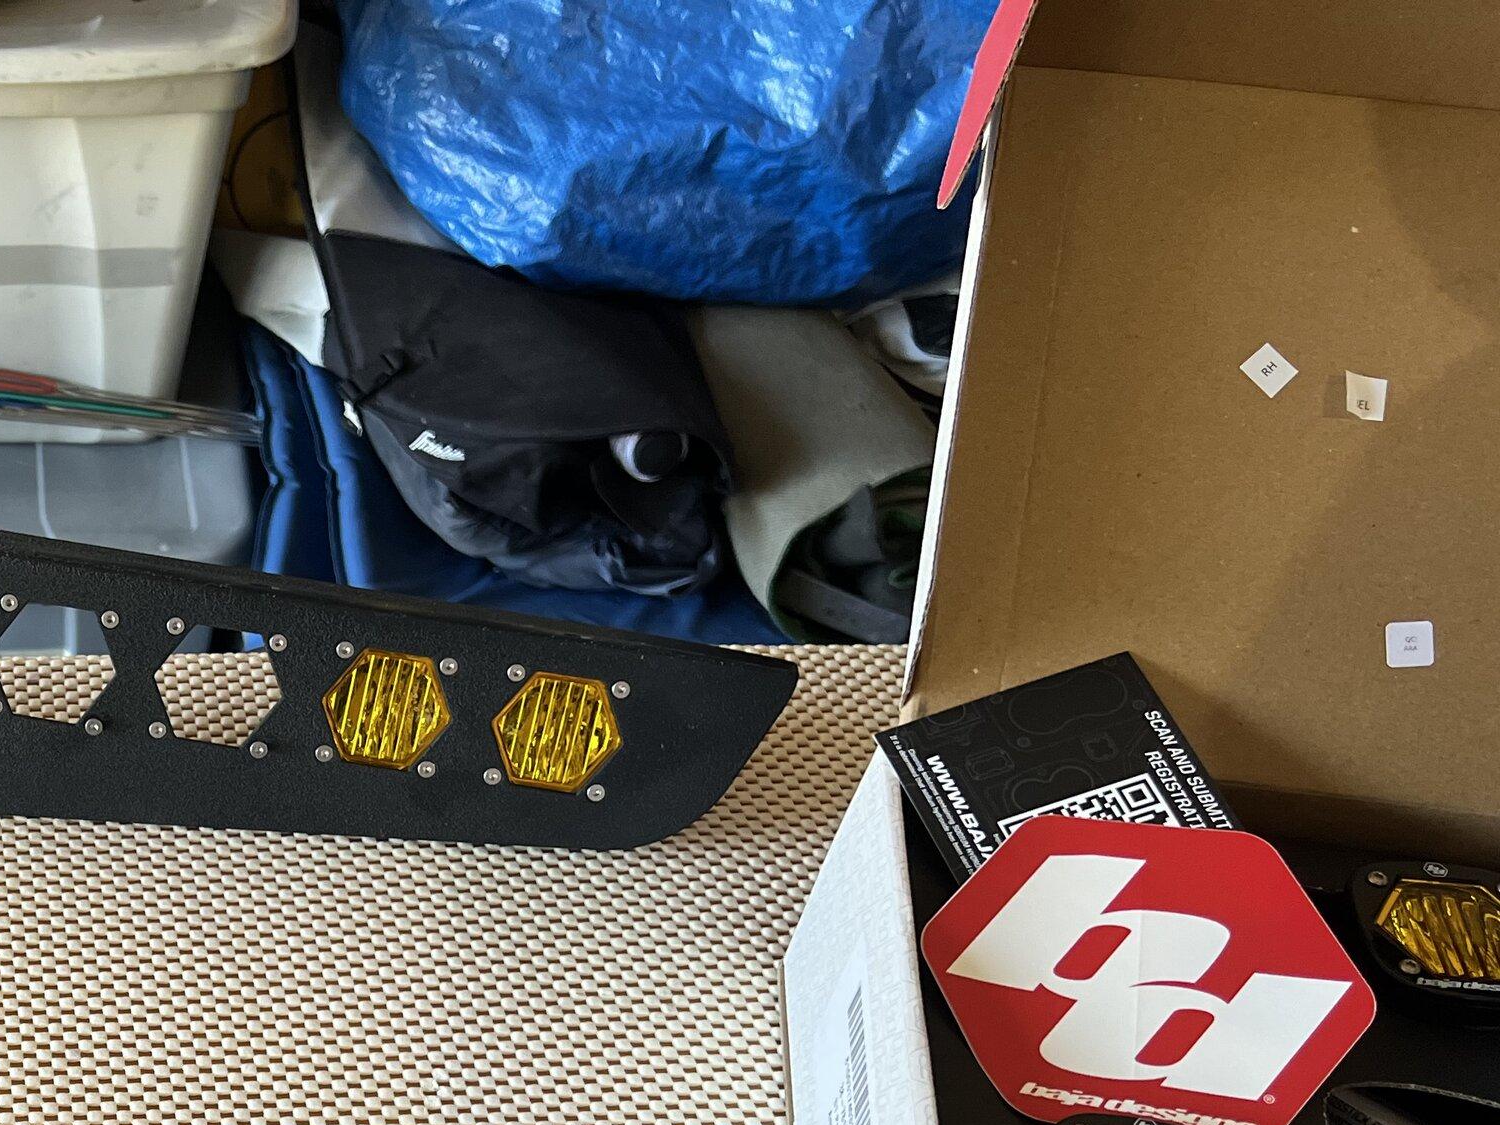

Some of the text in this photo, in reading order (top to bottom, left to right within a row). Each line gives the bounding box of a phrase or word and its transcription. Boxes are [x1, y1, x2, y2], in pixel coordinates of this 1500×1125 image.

[1261, 361, 1278, 377] RH
[1144, 710, 1234, 830] SCAN AND SUBMIT
[1018, 1081, 1104, 1109] baja
